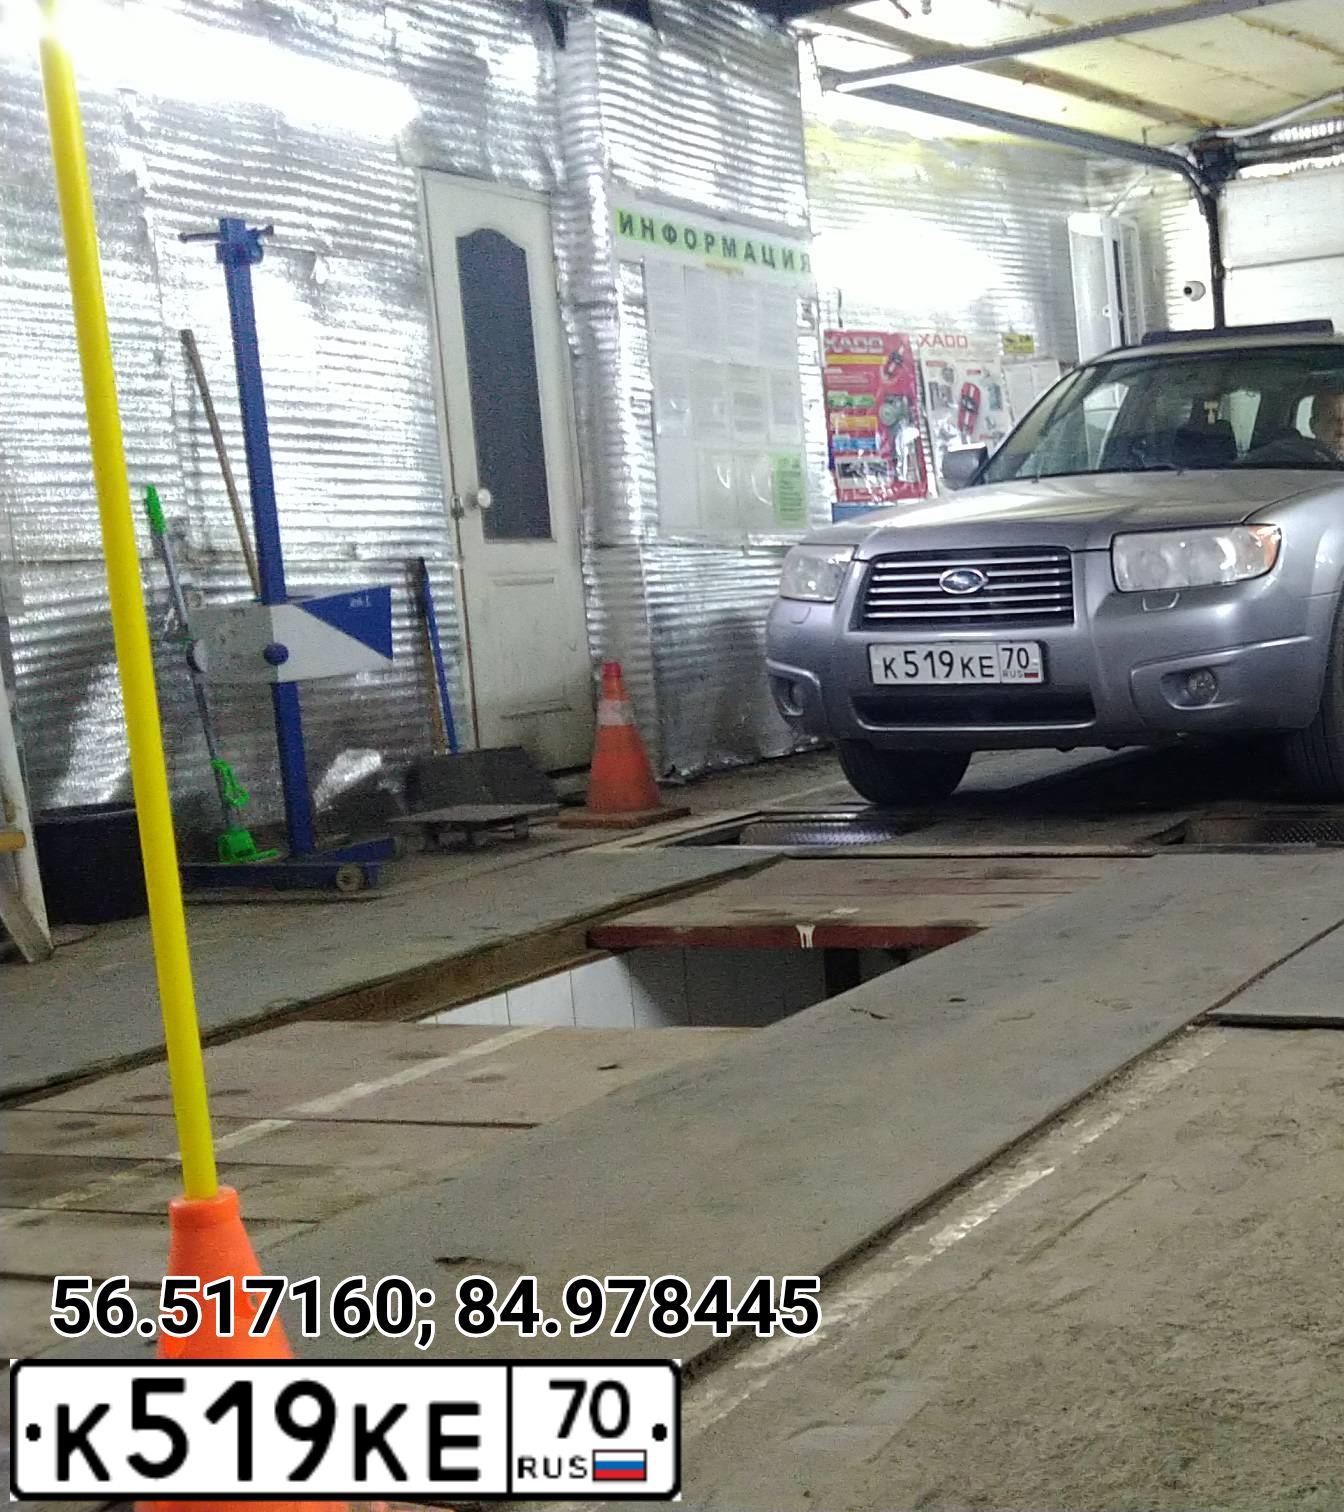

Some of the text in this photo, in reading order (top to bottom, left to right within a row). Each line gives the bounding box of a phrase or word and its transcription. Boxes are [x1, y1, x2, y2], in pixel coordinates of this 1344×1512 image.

[618, 211, 811, 273] ИНФОРМАЦИЯ
[918, 333, 969, 349] XADO
[1001, 647, 1030, 670] 70
